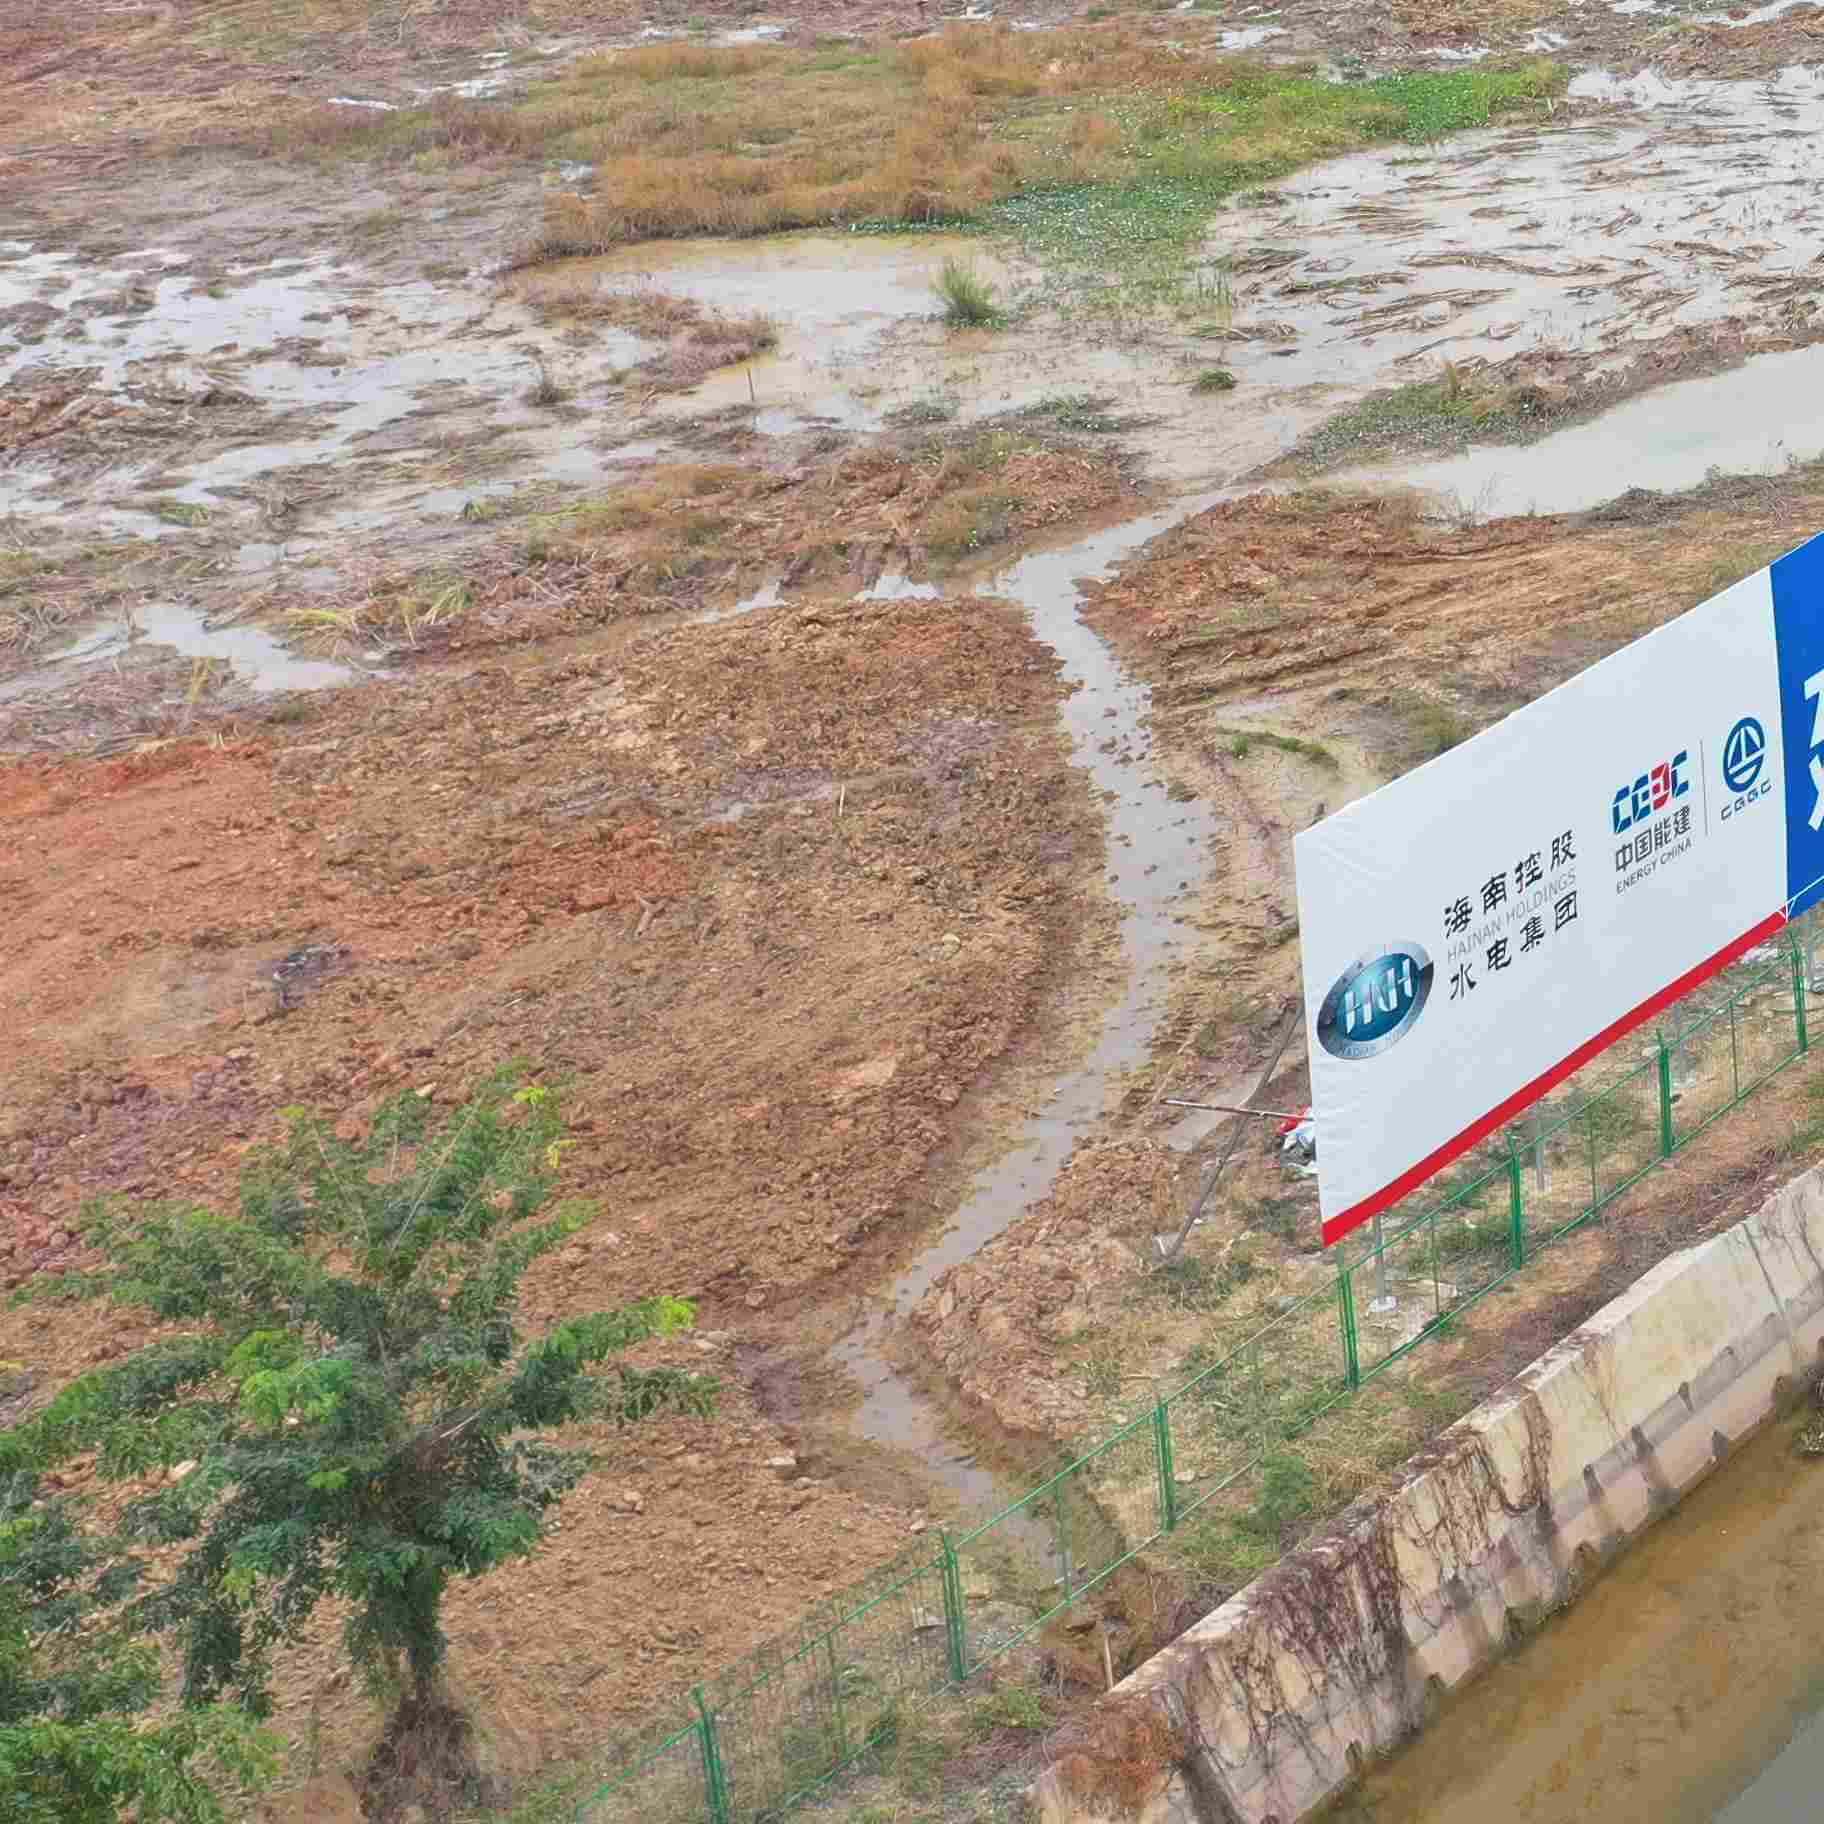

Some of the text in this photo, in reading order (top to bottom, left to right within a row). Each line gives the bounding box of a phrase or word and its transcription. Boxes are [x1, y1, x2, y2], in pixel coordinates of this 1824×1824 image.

[1615, 804, 1691, 872] 中国能建
[1720, 777, 1772, 821] CGGC
[1444, 829, 1576, 939] 海南控股
[1616, 837, 1692, 894] ENERGY CHINA
[1448, 869, 1576, 962] HAINAN HOLDINGS
[1450, 890, 1577, 1000] 水电集团
